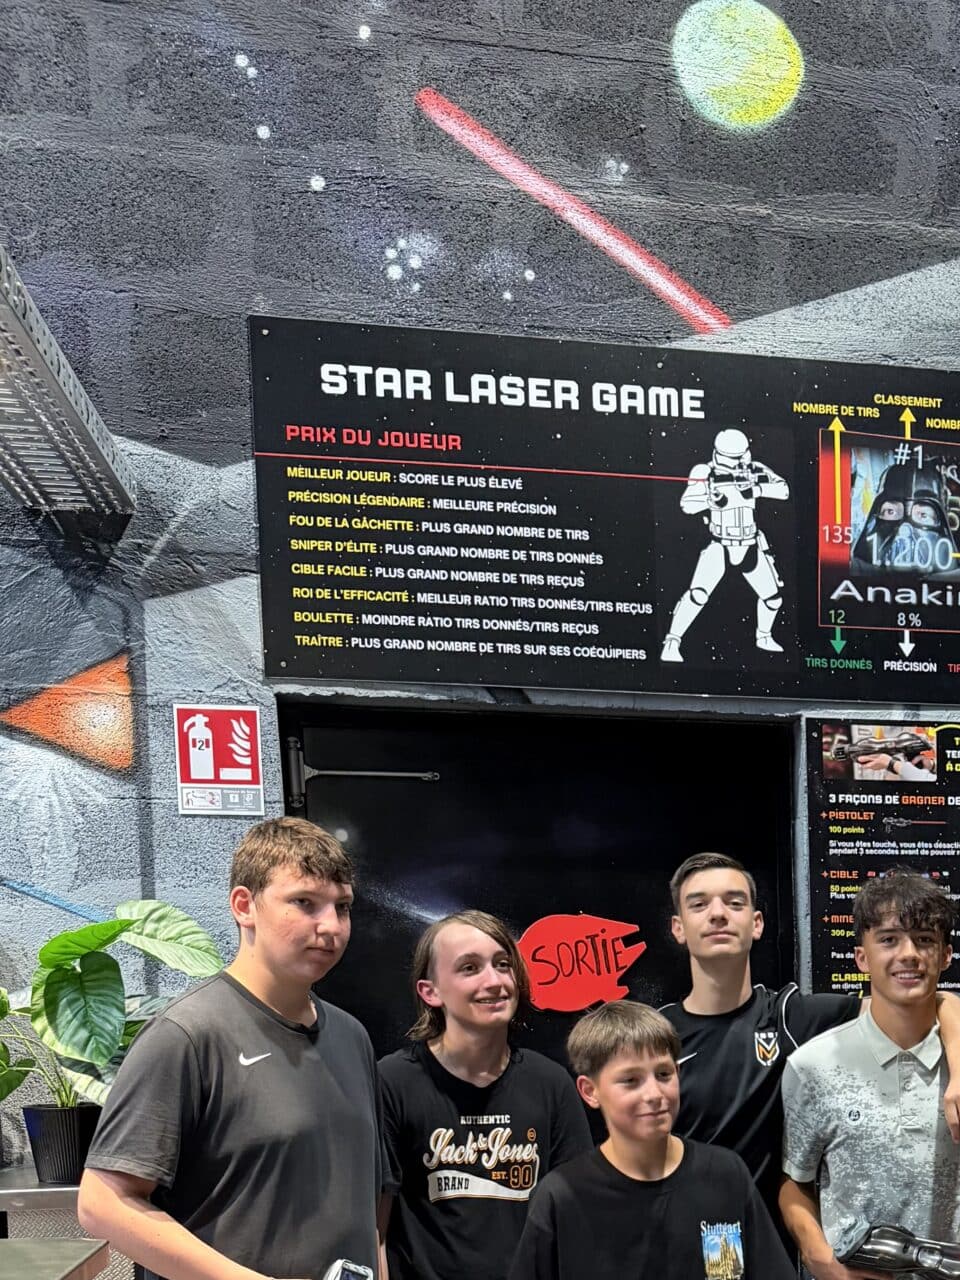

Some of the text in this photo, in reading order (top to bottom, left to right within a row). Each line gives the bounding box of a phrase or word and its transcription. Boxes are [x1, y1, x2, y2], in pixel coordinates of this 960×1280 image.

[320, 363, 705, 418] STAR LASER GAME
[793, 402, 880, 417] NOMBRE DE TIRS
[873, 394, 942, 408] CLASSEMENT
[286, 425, 461, 451] PRIX DU JOUEUR
[894, 442, 924, 469] #1
[287, 466, 522, 489] MEILLEUR JOUEUR SCORE LE PLUS ÉLEVÉ
[288, 490, 556, 515] PRÉCISION LÉGENDAIRE MEILLEURE PRÉCISION
[289, 514, 589, 540] FOU DE LA GÂCHETTE PLUS GRAND NOMBRE DE TIRS
[822, 525, 852, 544] 135
[290, 539, 603, 564] SNIPER D'ÉLITE PLUS GRAND NOMBRE DE TIRS DONNÉS
[291, 563, 584, 588] CIBLE FACILE PLUS GRAND NOMBRE DE TIRS REÇUS
[292, 587, 652, 615] ROI DE L'EFFICACITÉ MEILLEUR RATIO TIRS DONNÉS/TIRS REÇUS
[294, 611, 599, 635] BOULETTE MOINDRE RATIO TIRS DONNÉS/TIRS REÇUS
[828, 610, 845, 624] 12
[897, 613, 906, 626] 8
[294, 634, 646, 659] TRAÎTRE PLUS GRAND NOMBRE DE TIRS SUR SES COÉQUIPIERS
[805, 657, 873, 670] TIRS DONNÉS
[883, 659, 937, 673] PRÉCISION
[197, 739, 205, 751] 2
[828, 793, 836, 803] 3
[838, 794, 882, 806] FAÇONS
[884, 794, 899, 804] DE
[901, 795, 945, 805] GAGNER
[828, 811, 875, 820] PISTOLET
[828, 826, 865, 835] 100 points
[829, 870, 859, 879] CIBLE
[460, 1114, 511, 1125] AUTHENTIC
[437, 1176, 470, 1192] BRAND
[491, 1165, 533, 1188] EST. 90
